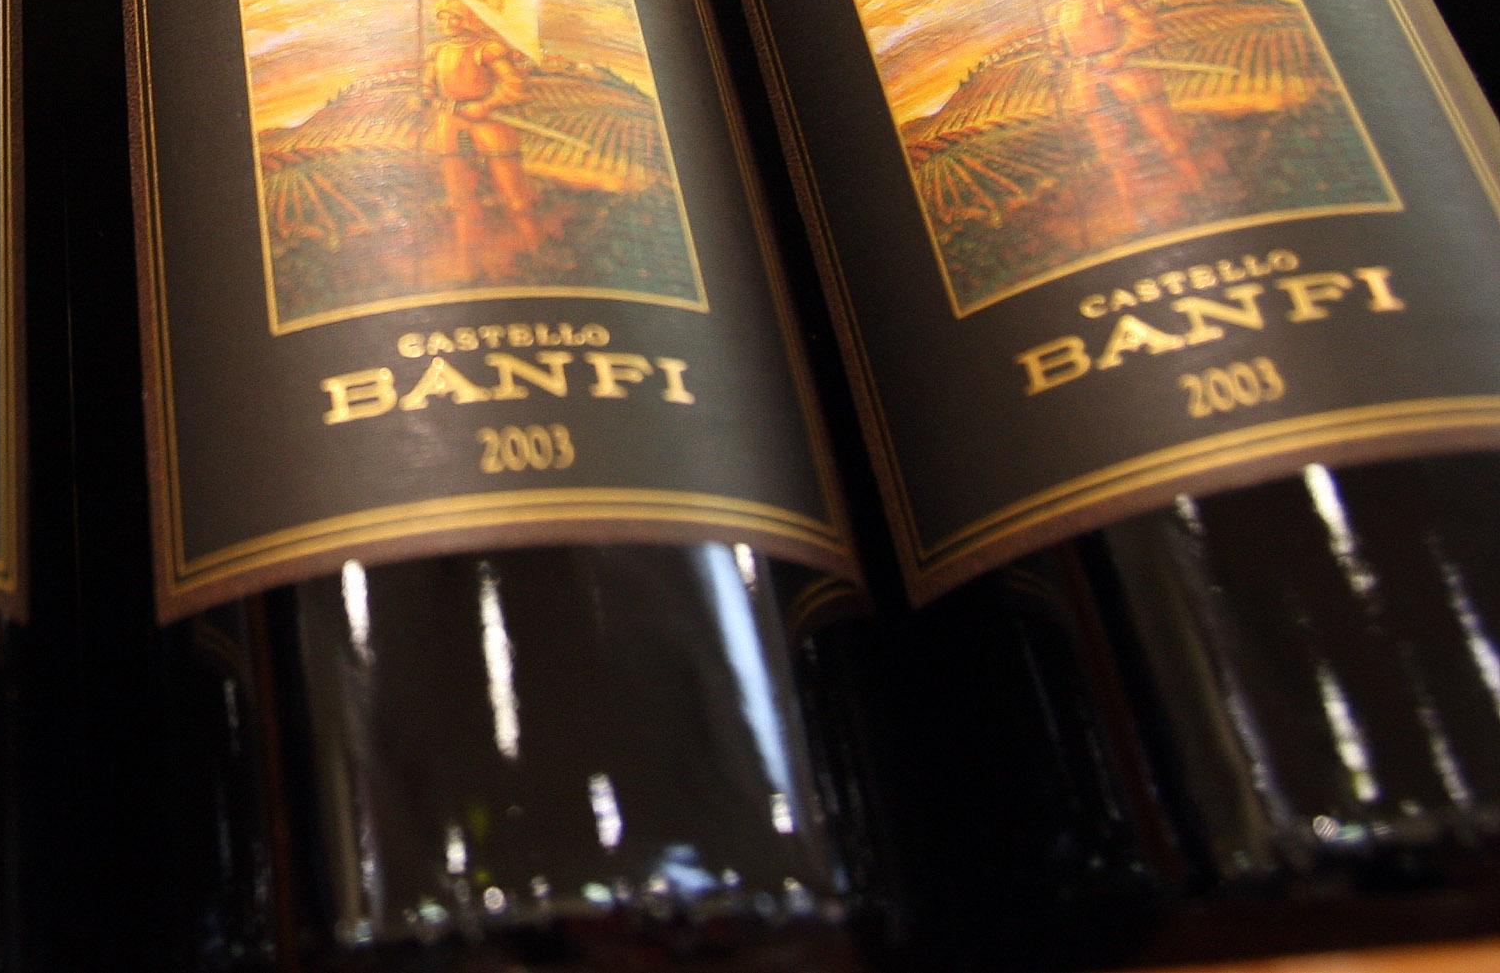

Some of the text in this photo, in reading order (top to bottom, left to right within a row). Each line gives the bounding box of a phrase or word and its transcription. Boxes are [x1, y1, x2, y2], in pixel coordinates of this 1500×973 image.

[1078, 247, 1300, 320] CASTELLO
[397, 323, 610, 359] CASTELLO
[1014, 265, 1407, 397] BANFI
[320, 350, 696, 425] BANFI
[1178, 355, 1286, 419] 2003
[478, 423, 575, 475] 2003
